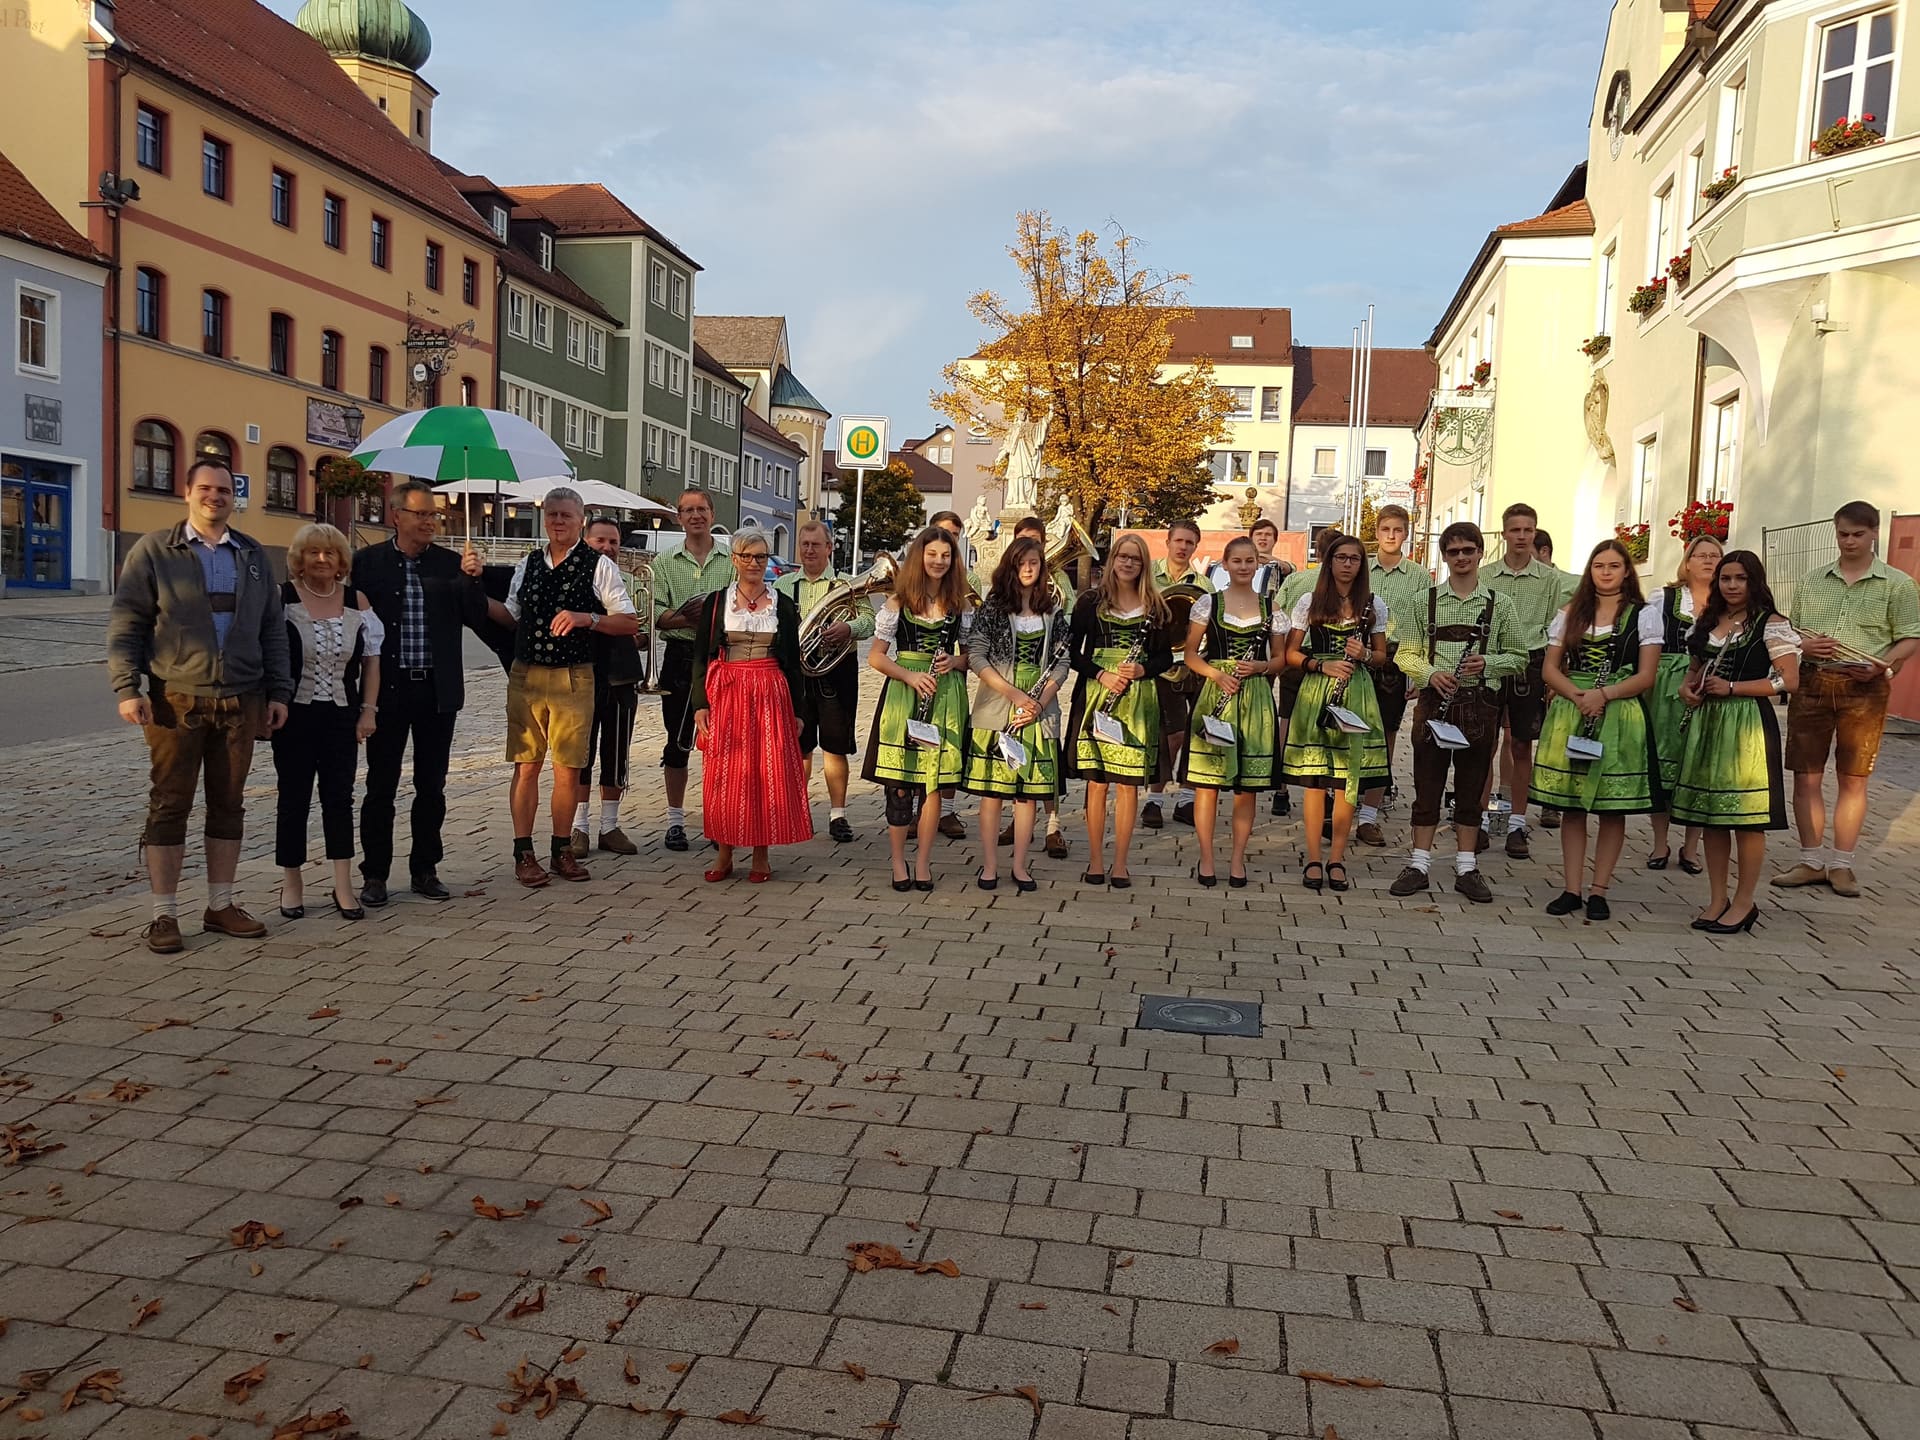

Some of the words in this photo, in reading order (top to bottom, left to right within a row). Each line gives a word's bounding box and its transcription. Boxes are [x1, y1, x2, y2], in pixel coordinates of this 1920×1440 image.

[15, 8, 45, 33] Post
[856, 432, 871, 452] H
[234, 476, 245, 495] P
